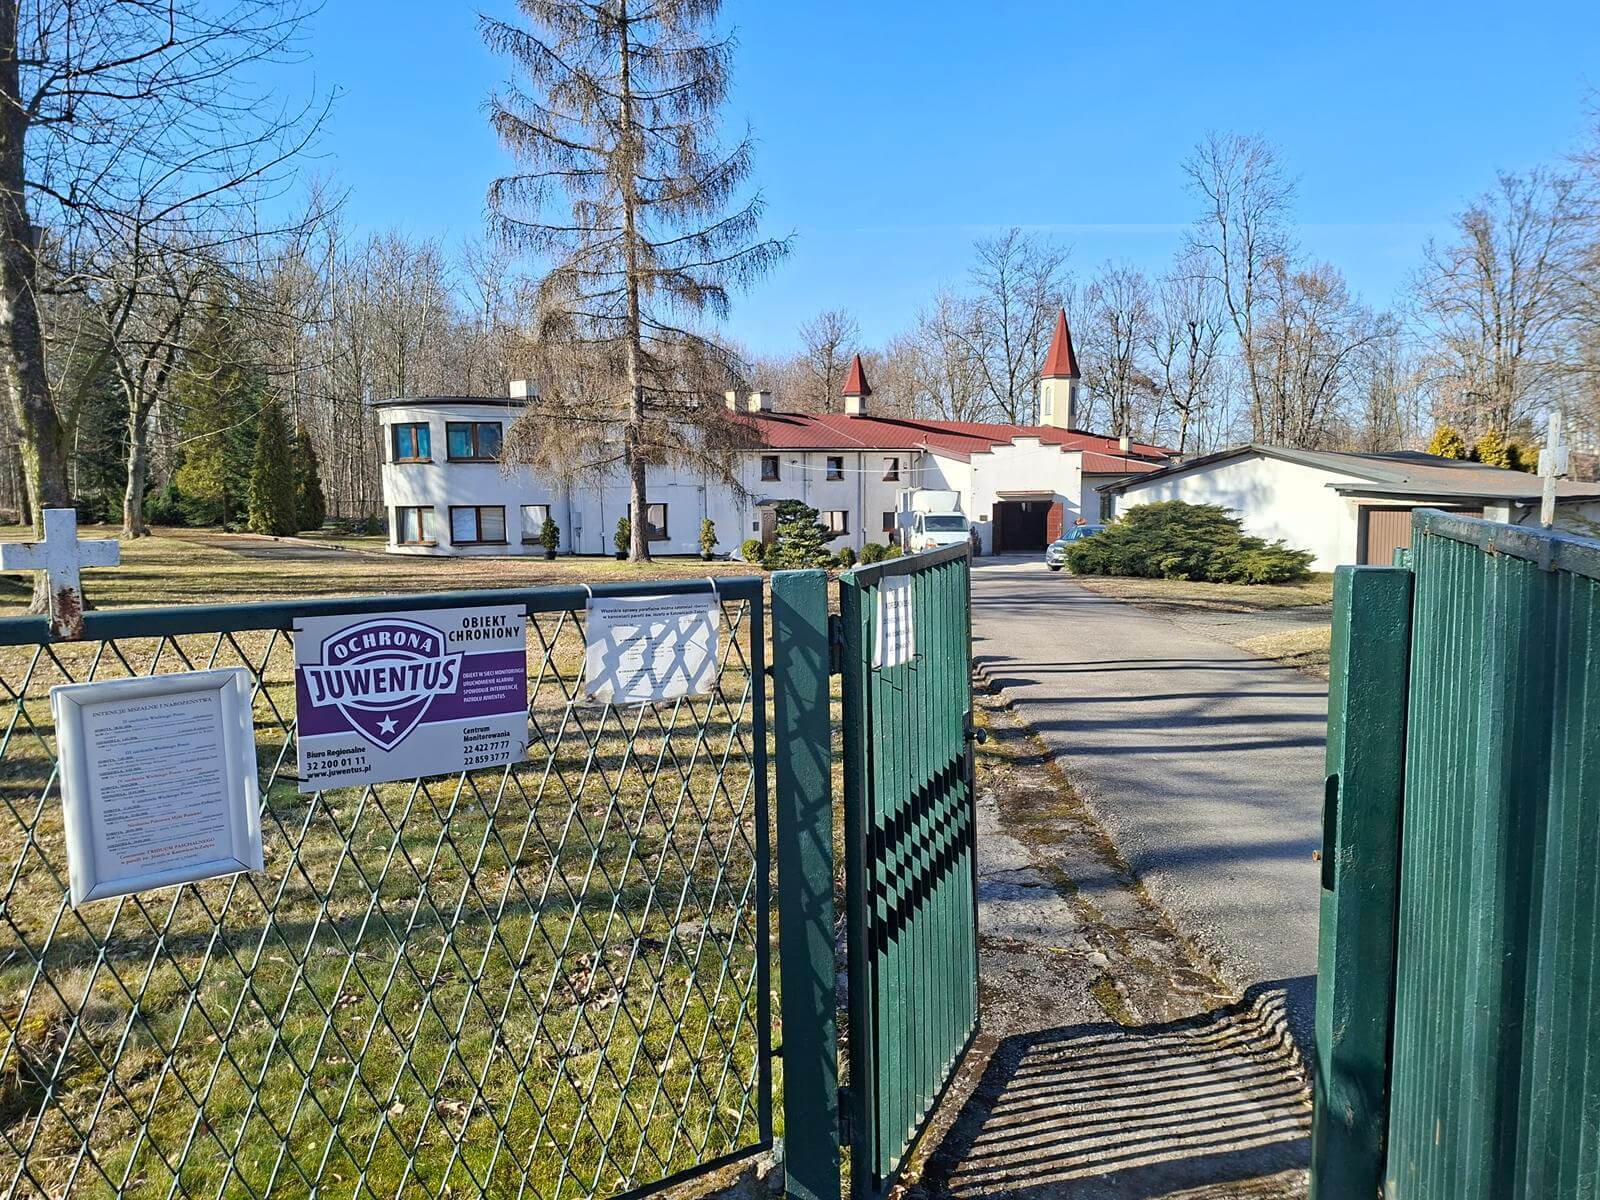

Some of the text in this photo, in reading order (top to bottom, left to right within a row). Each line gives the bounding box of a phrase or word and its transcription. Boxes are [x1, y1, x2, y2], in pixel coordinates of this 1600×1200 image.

[462, 615, 506, 628] OBIEKT
[449, 626, 520, 642] CHRONIONY
[334, 631, 432, 659] OCHRONA
[310, 658, 456, 702] JUWENTUS
[463, 726, 490, 734] Centrum
[464, 730, 510, 742] Monitorowania
[327, 746, 366, 757] Regionalne
[464, 746, 473, 754] 22
[474, 744, 488, 752] 422
[490, 742, 499, 750] 77
[307, 762, 318, 771] 32
[321, 760, 338, 769] 200
[341, 758, 351, 766] 01
[464, 757, 473, 765] 22
[475, 755, 489, 763] 859
[490, 753, 499, 761] 37
[307, 764, 371, 779] www.juwentus.pl
